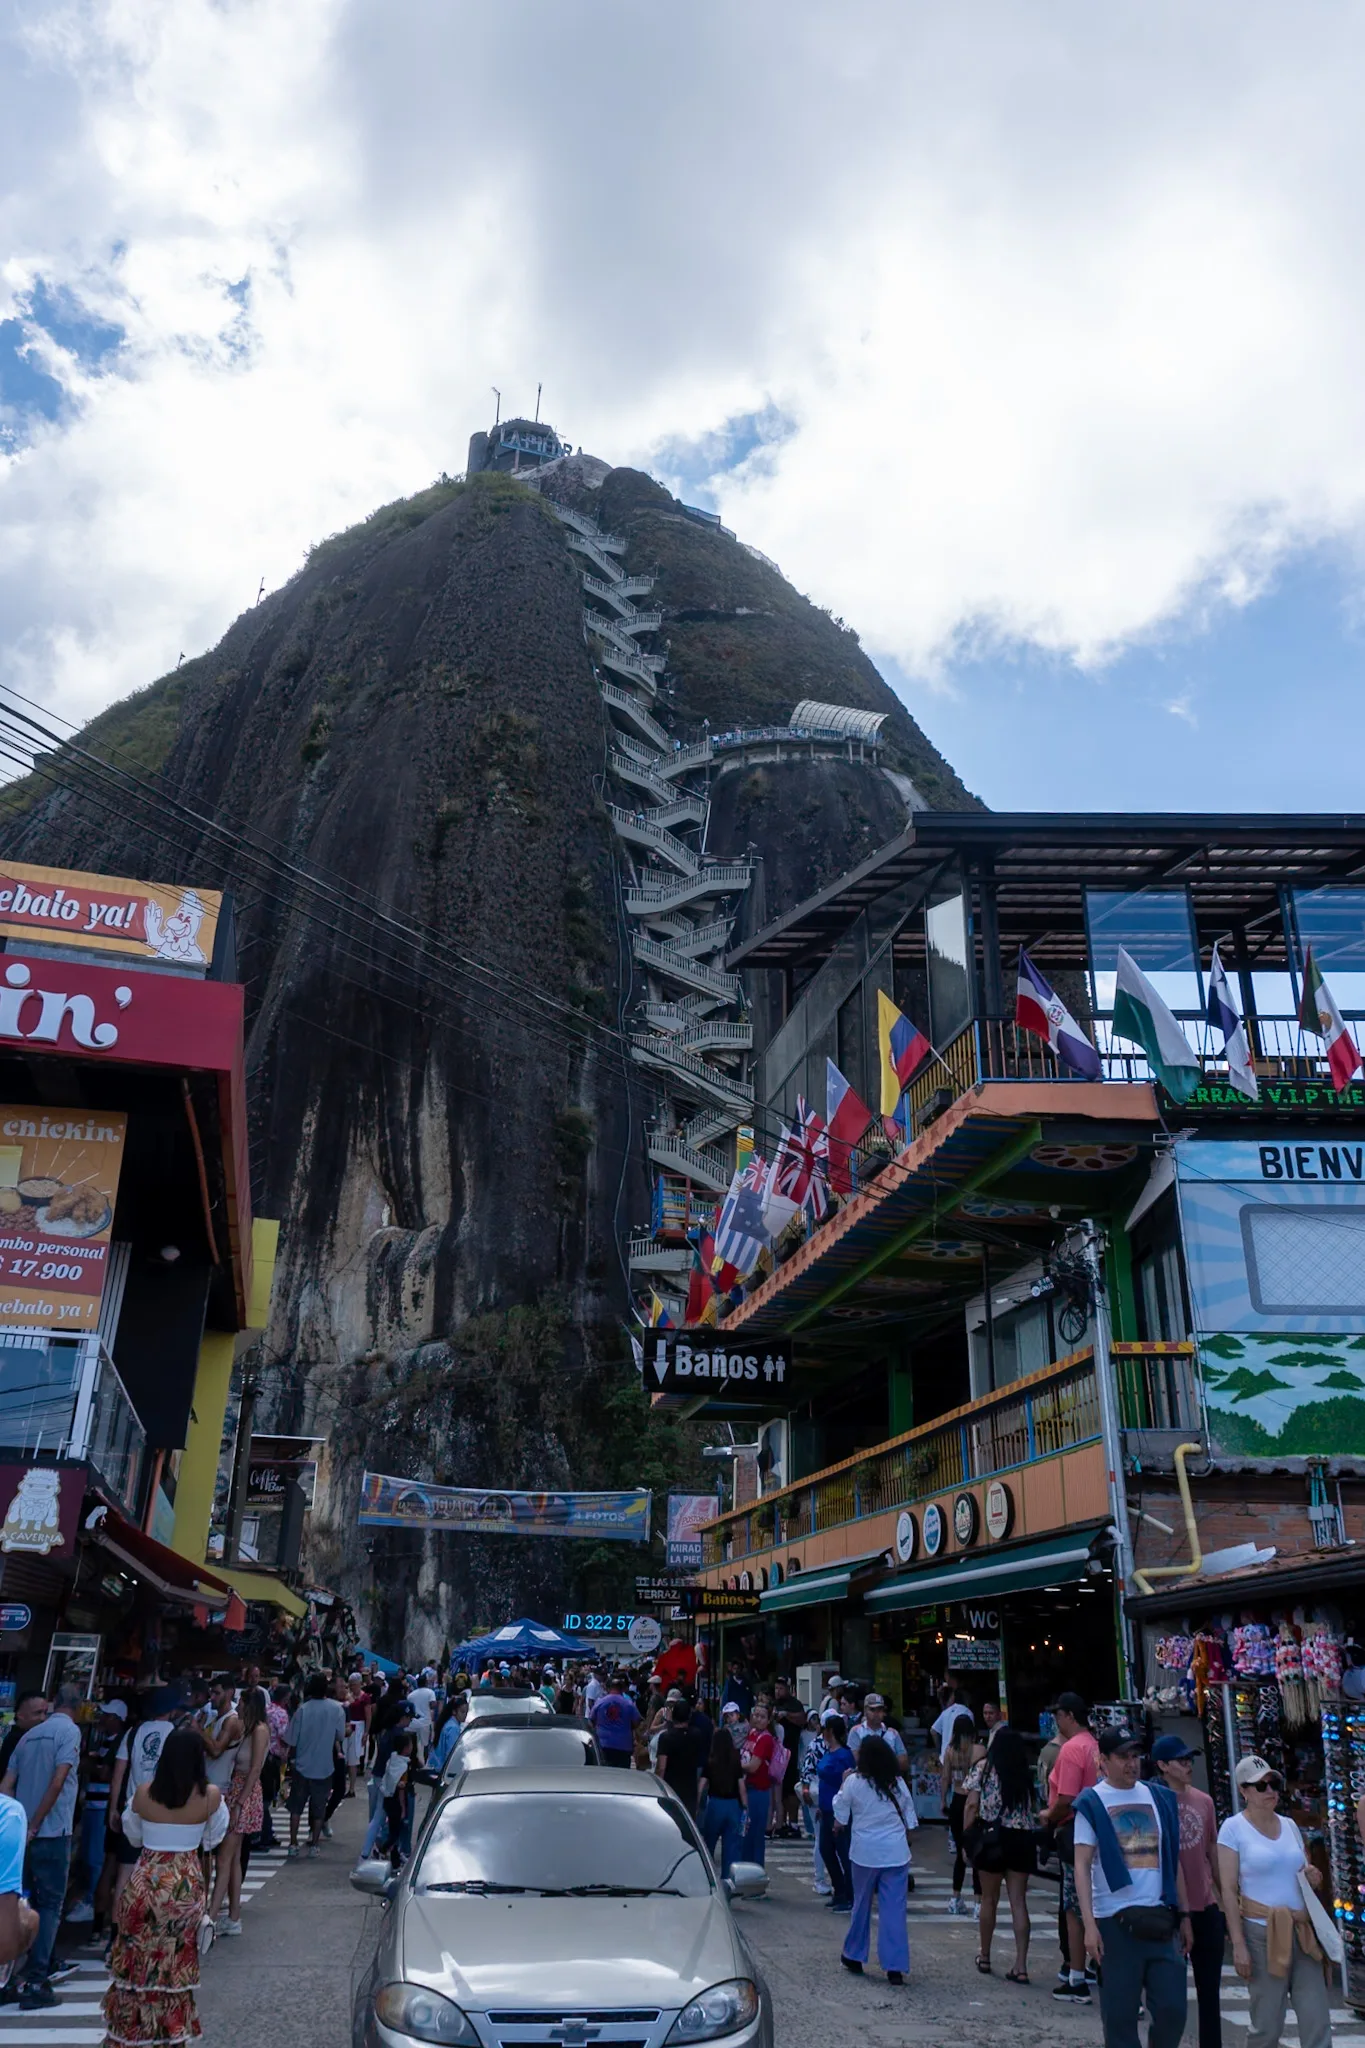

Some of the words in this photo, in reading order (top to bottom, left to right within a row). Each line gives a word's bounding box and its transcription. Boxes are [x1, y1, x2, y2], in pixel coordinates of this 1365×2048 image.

[83, 902, 138, 930] ya!
[1258, 1146, 1364, 1179] BIENV
[34, 1243, 106, 1260] personal
[8, 1259, 83, 1280] 17.900
[57, 1305, 81, 1320] ya
[675, 1345, 758, 1380] Baños
[249, 1469, 281, 1491] Coffee
[585, 1511, 627, 1522] FOTOS
[10, 1532, 64, 1544] CAVERNA
[670, 1555, 681, 1564] LA
[636, 1589, 681, 1600] TERRAZ
[702, 1591, 746, 1606] Baños
[585, 1615, 612, 1630] 322
[969, 1610, 999, 1629] WC
